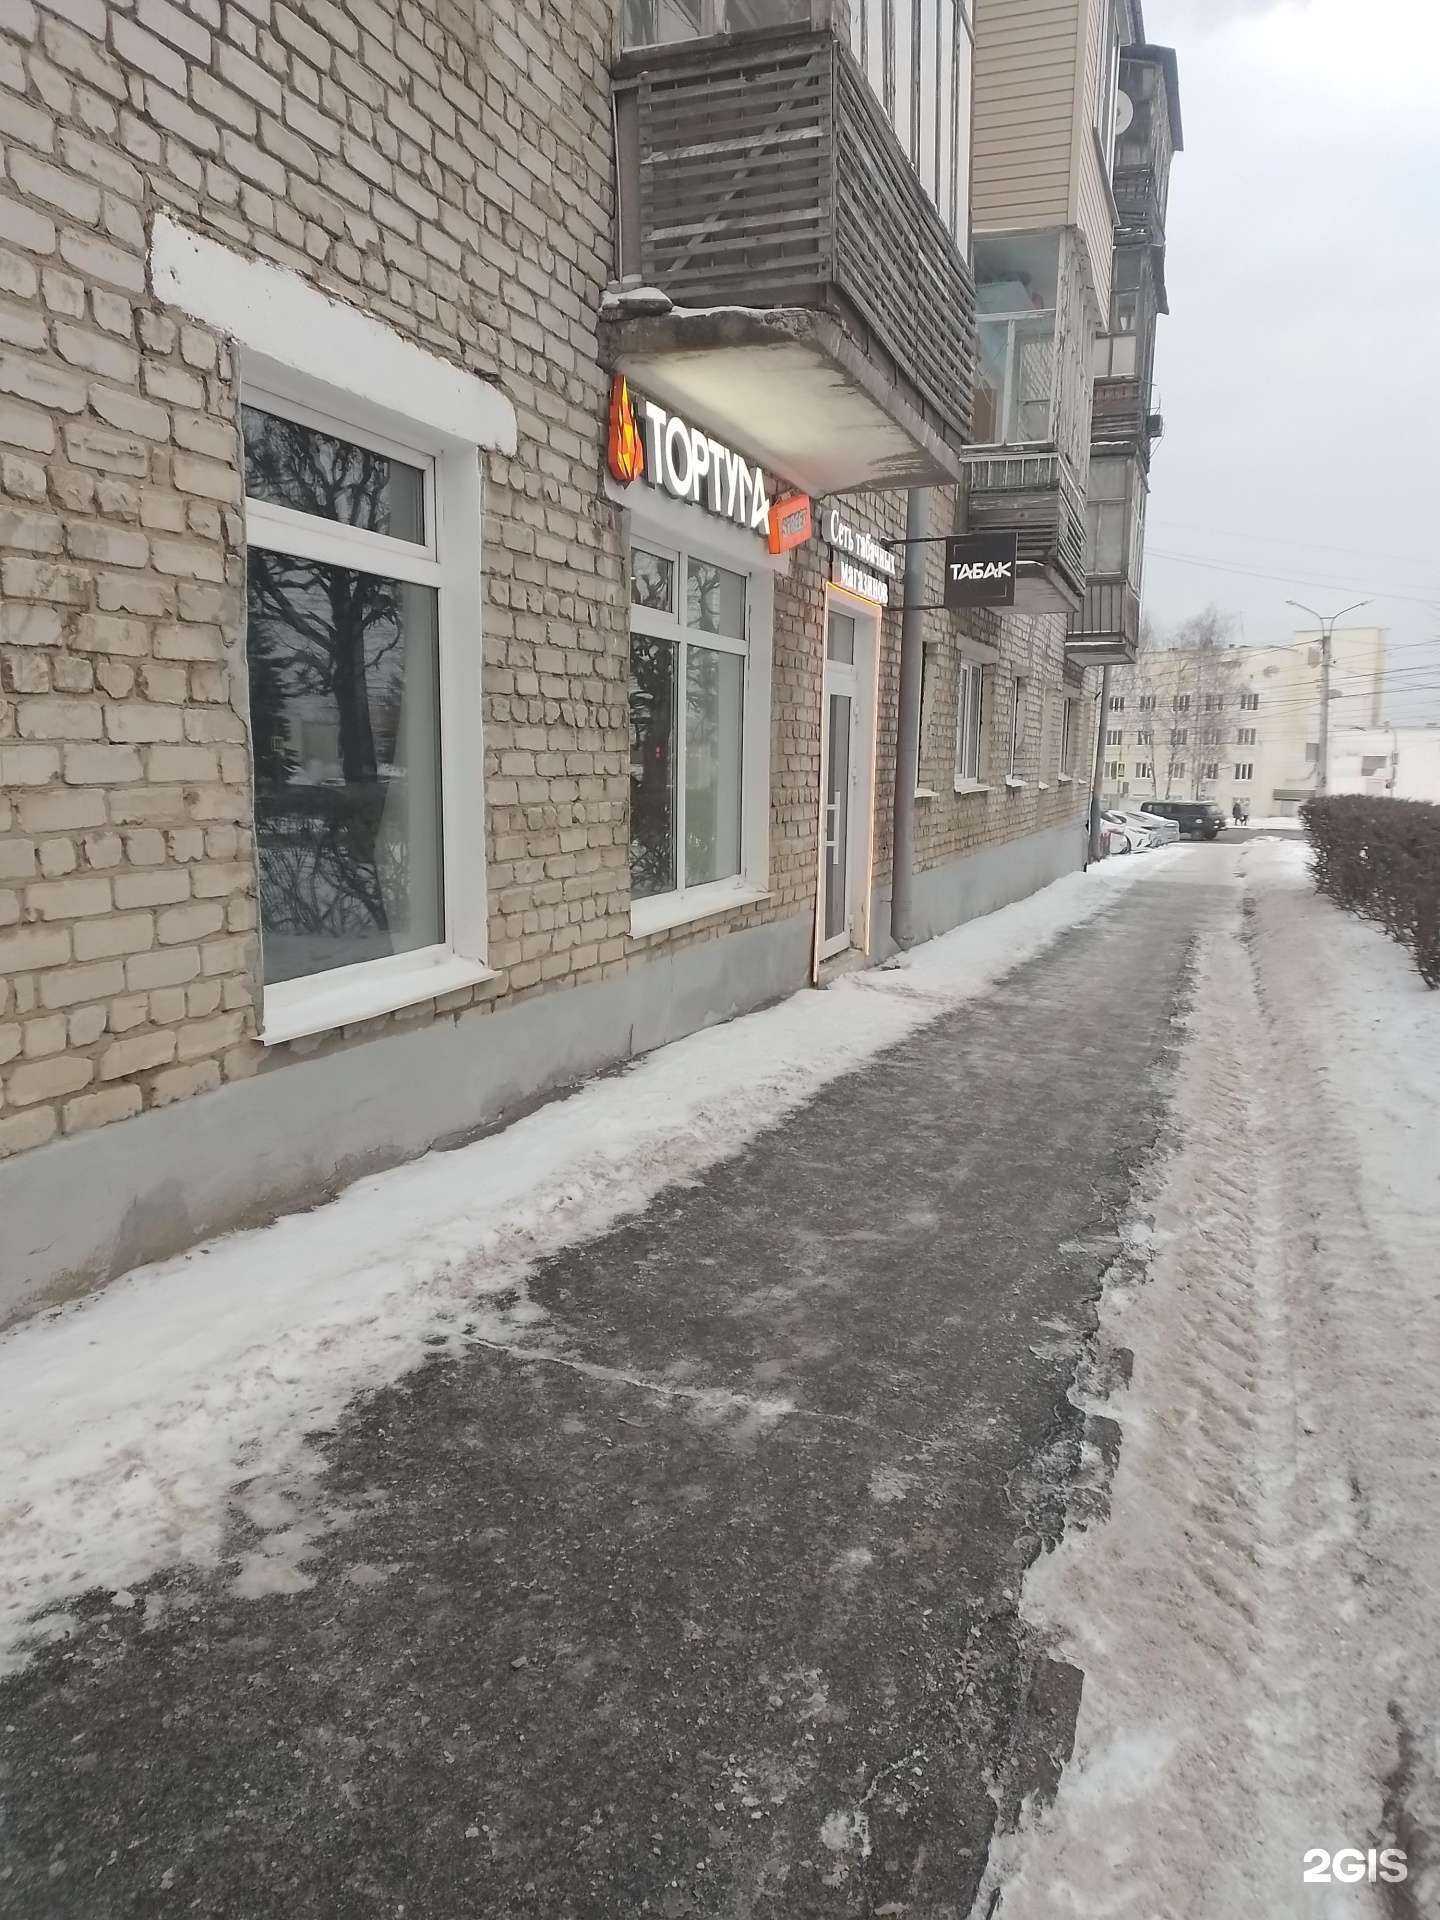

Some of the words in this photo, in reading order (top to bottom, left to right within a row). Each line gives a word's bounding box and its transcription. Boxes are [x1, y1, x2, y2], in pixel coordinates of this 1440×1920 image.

[646, 401, 770, 534] ТОРТУГА
[831, 509, 854, 551] Сеть
[855, 533, 895, 575] табачных
[841, 561, 888, 604] магазинов
[950, 562, 1012, 580] ТАБАК
